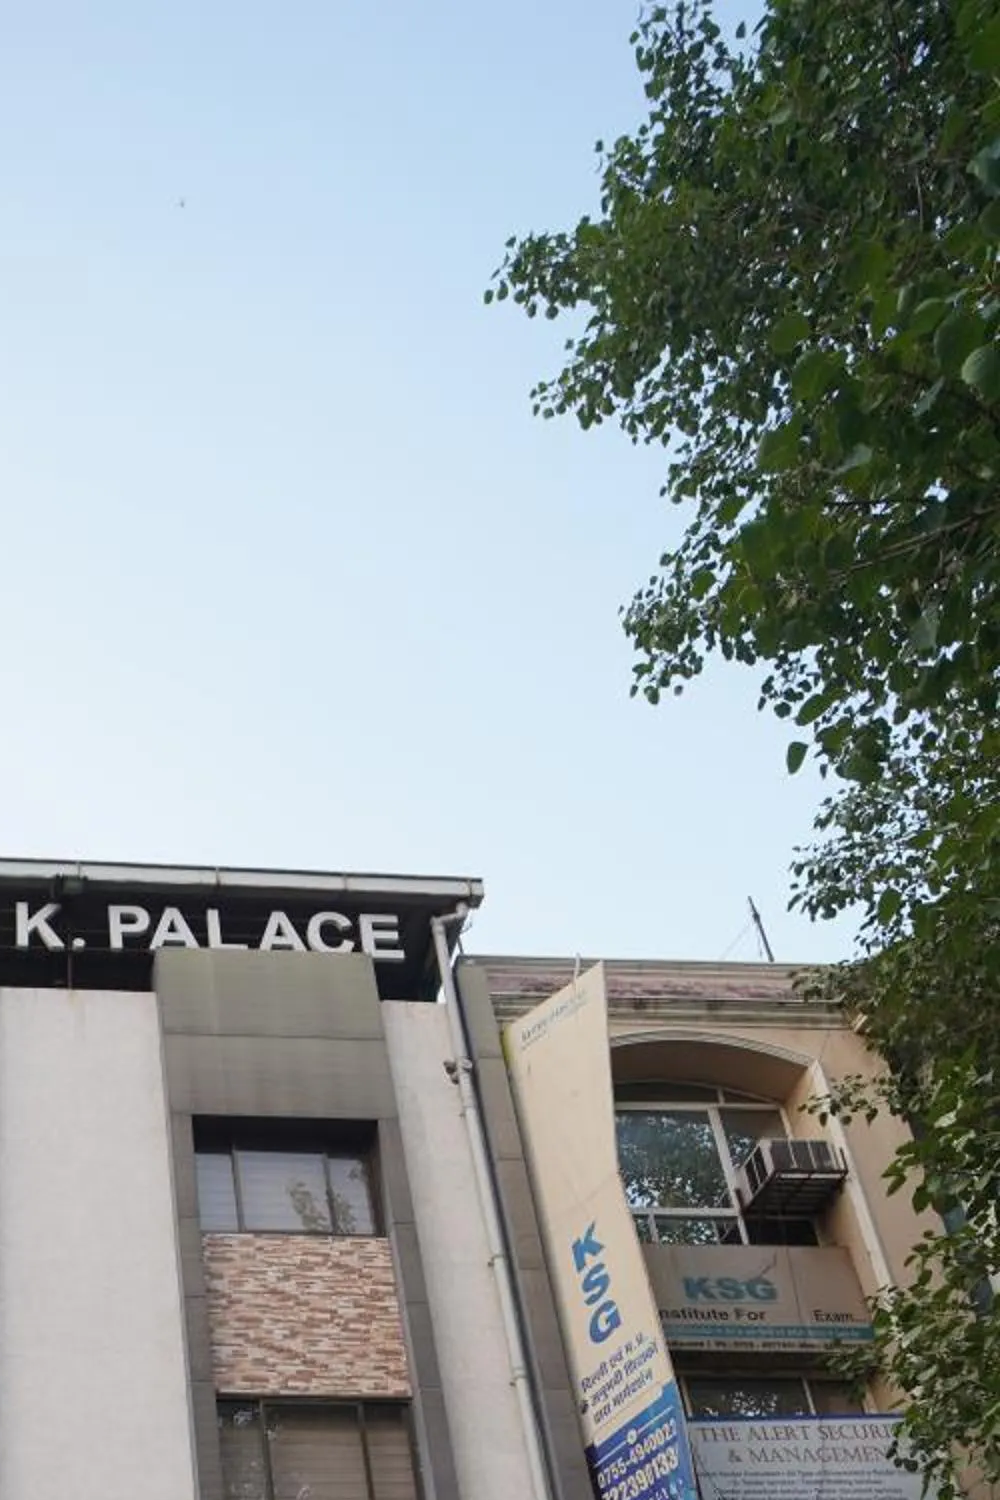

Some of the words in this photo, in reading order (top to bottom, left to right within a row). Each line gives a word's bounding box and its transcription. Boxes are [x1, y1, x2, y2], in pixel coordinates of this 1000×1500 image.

[14, 901, 86, 950] K.
[107, 904, 406, 960] PALACE
[572, 1221, 623, 1344] KSG
[683, 1276, 777, 1300] KSG
[659, 1307, 729, 1321] nstitute
[733, 1307, 766, 1321] For
[697, 1427, 741, 1441] THE
[748, 1426, 810, 1441] ALERT
[818, 1424, 893, 1440] SECURI
[728, 1449, 743, 1462] &
[747, 1447, 894, 1462] MANAGEMEN
